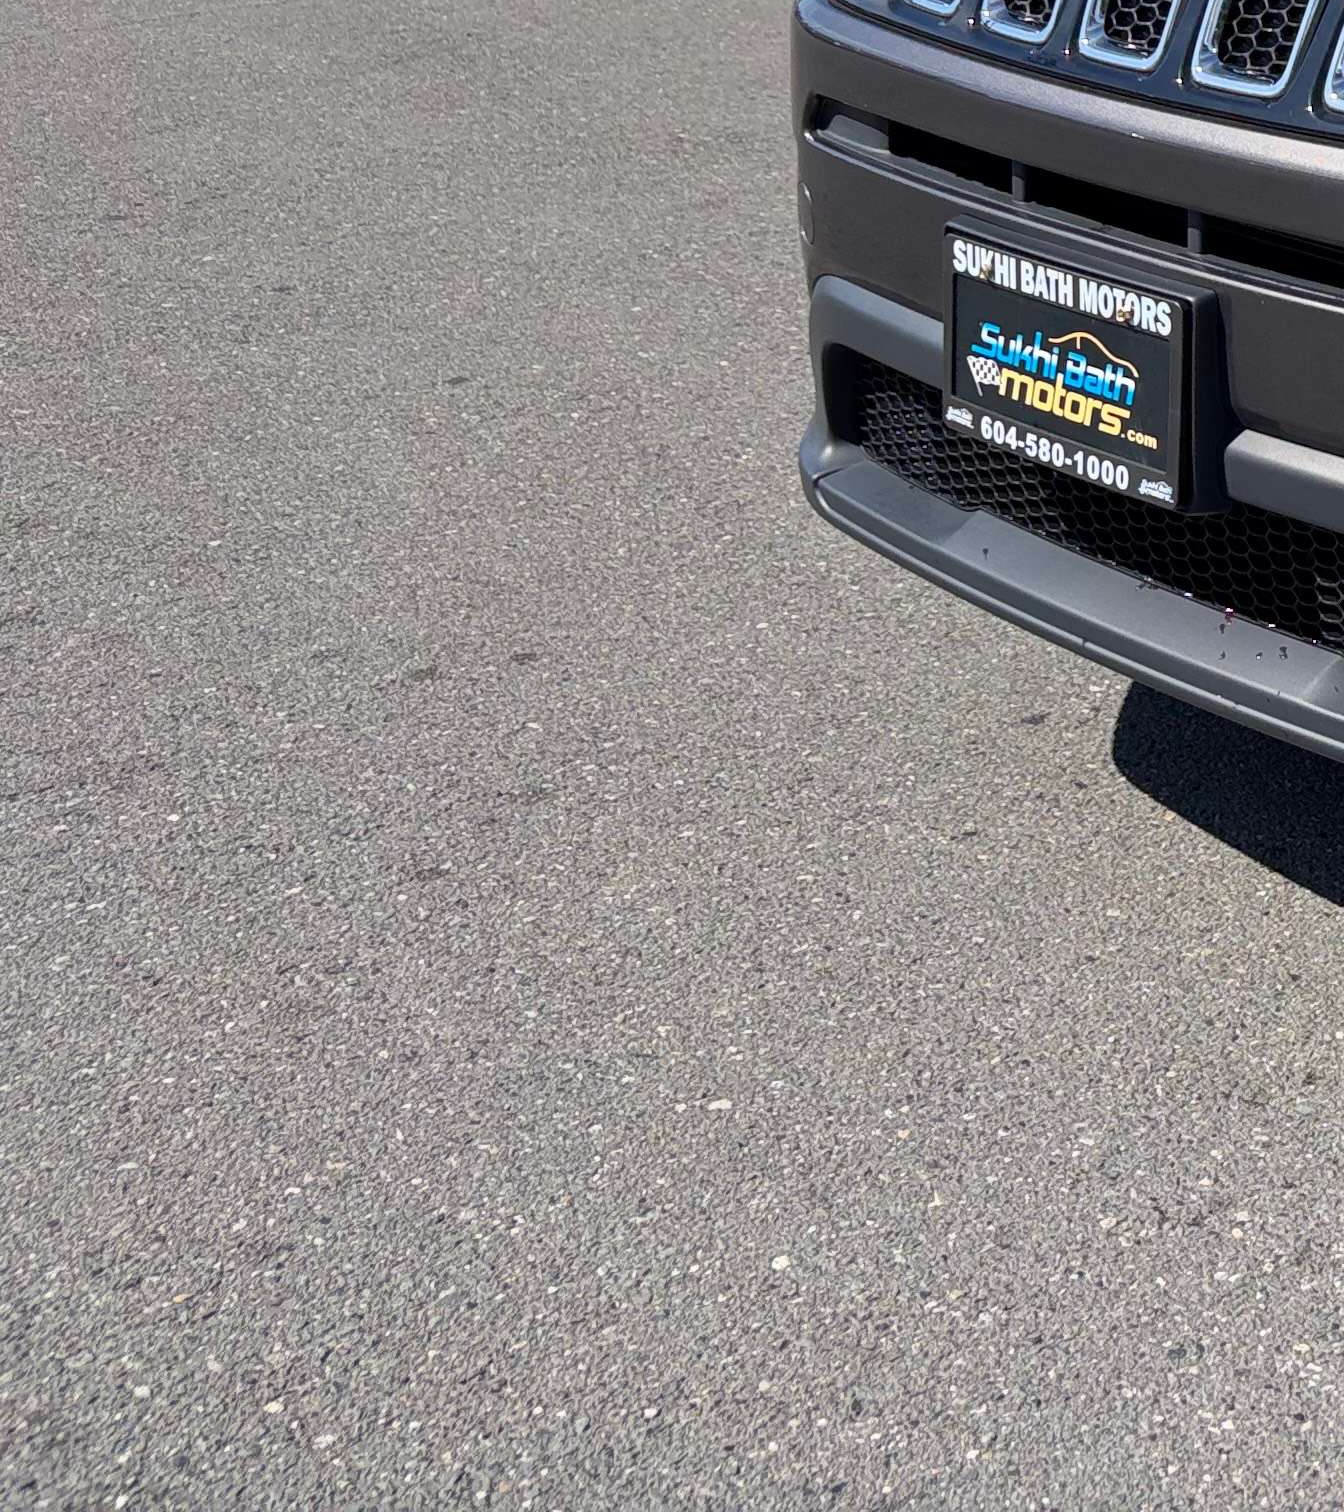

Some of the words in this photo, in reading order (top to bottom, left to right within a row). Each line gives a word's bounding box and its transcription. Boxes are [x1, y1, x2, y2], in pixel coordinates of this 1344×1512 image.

[952, 238, 1017, 290] SUKHI
[1020, 260, 1074, 312] BATH
[1079, 279, 1173, 337] MOTORS
[970, 321, 1061, 381] Sukhi
[1065, 350, 1136, 405] Bath
[980, 415, 1129, 490] 604-580-1000
